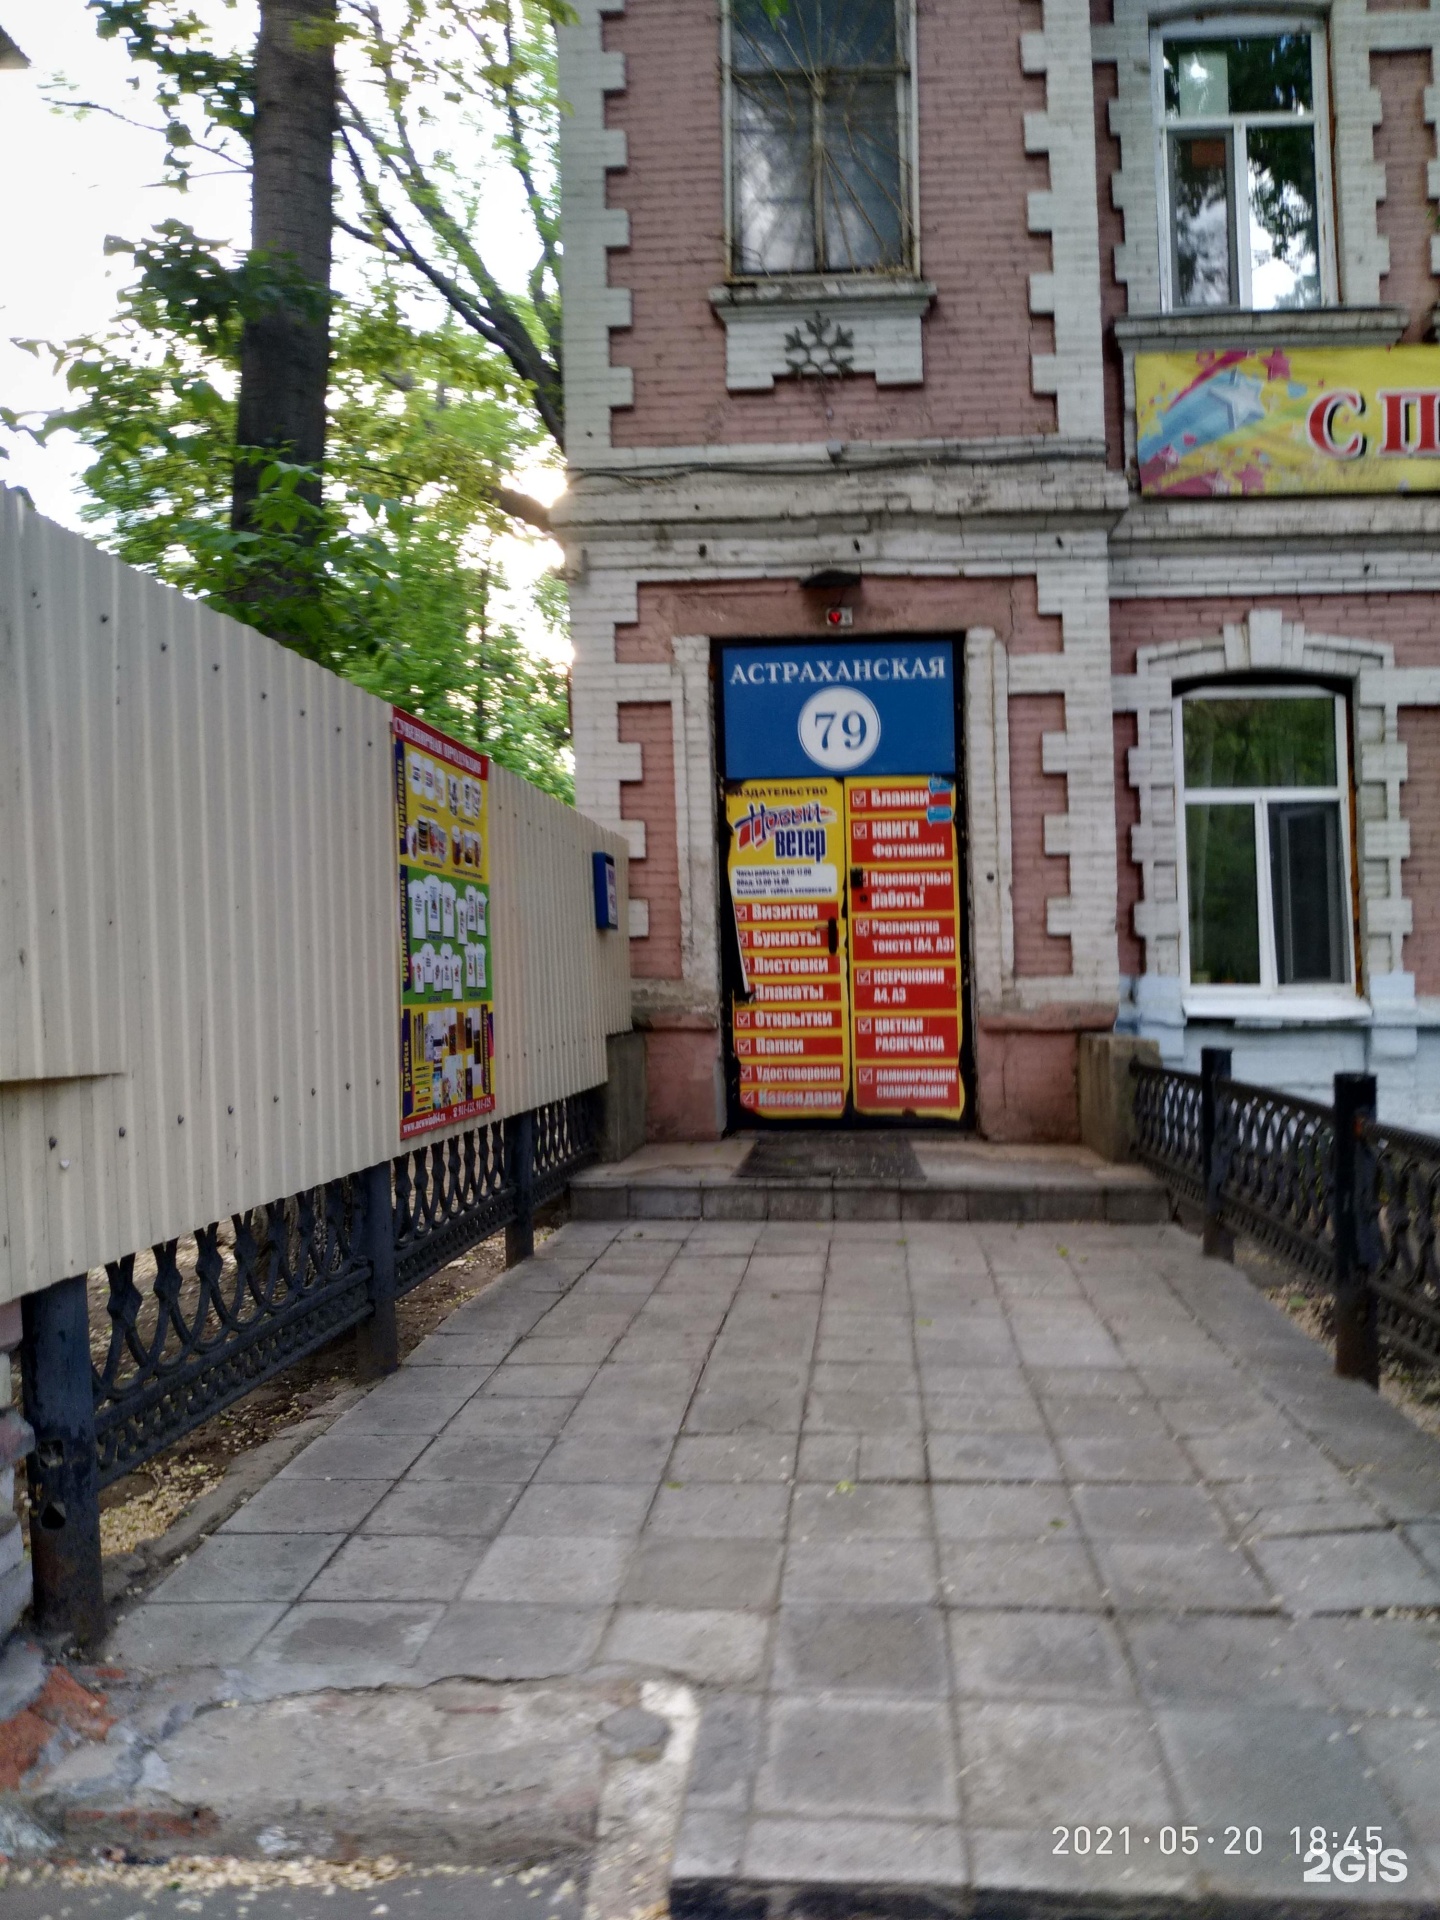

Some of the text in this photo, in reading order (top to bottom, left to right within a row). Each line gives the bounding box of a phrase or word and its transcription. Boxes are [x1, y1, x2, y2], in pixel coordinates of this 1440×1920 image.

[729, 657, 946, 686] АСТРАХАНСКАЯ
[814, 711, 868, 750] 79
[871, 789, 930, 807] Бланки
[871, 870, 951, 887] Переплетные
[871, 890, 925, 909] работы
[751, 903, 818, 920] Визитки
[872, 920, 940, 935] Распечатка
[752, 929, 822, 948] Буклеты
[872, 939, 911, 954] текста
[753, 956, 829, 974] Листовки
[874, 969, 945, 985] КСЕРОКОПИЯ
[754, 1010, 833, 1029] Открытки
[875, 1017, 923, 1035] ЦВЕТНАЯ
[755, 1037, 804, 1054] Папки
[875, 1036, 945, 1053] РАСПЕЧАТКА
[756, 1066, 841, 1082] Удостоверения
[876, 1069, 957, 1084] ЛАМИНИРОВАНИЕ
[757, 1089, 842, 1107] Календари
[876, 1084, 949, 1099] СКАНИРОВАНИЕ
